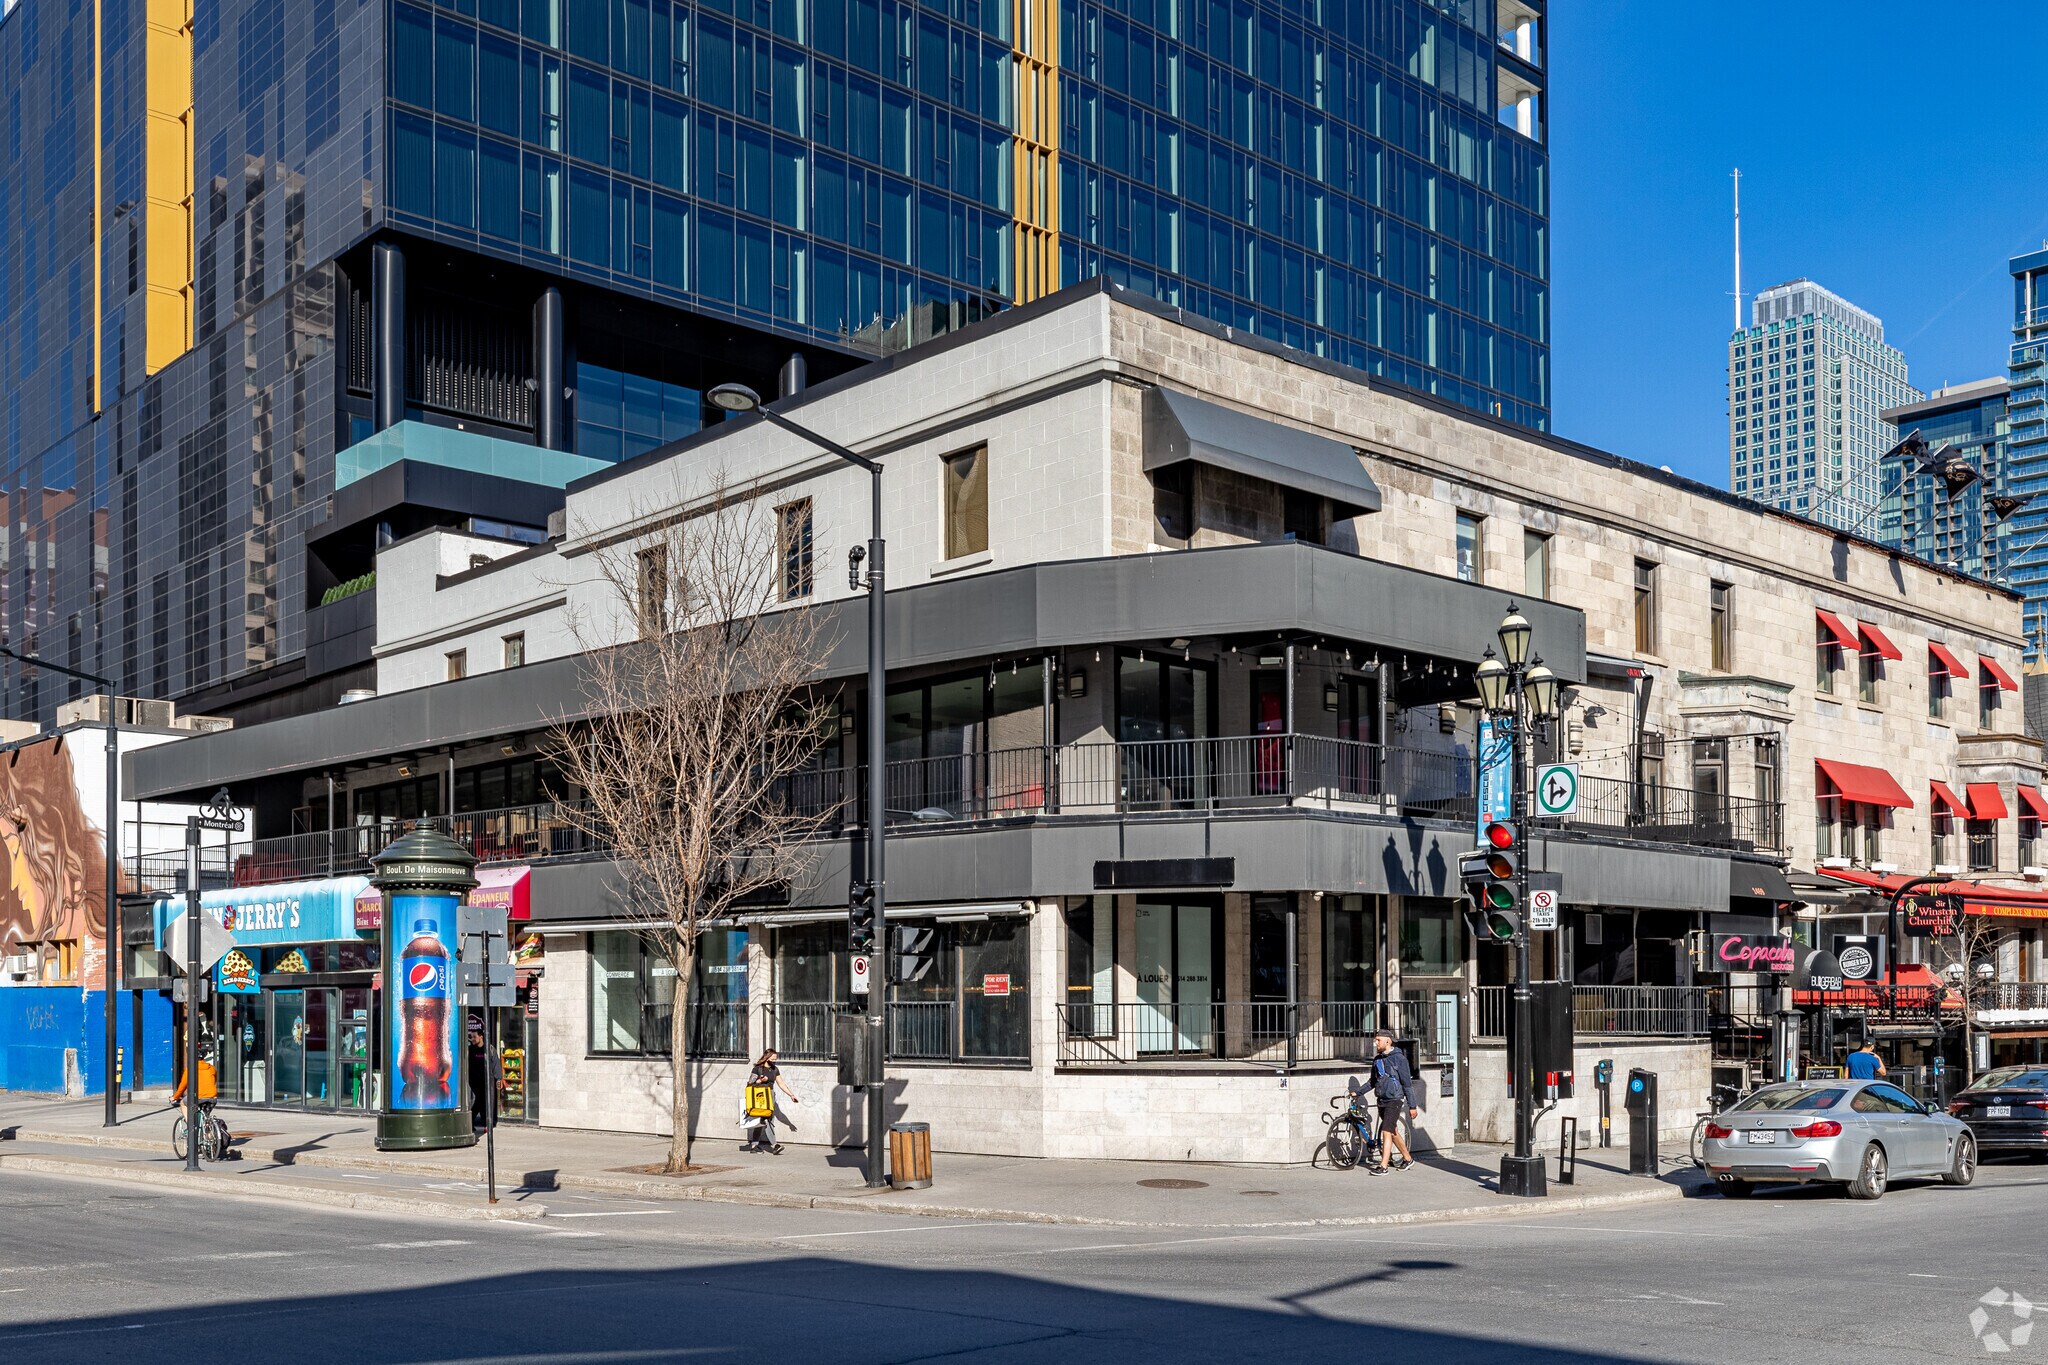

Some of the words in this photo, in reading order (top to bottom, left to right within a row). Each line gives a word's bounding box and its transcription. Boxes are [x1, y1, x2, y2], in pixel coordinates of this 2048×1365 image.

[203, 819, 234, 830] Montréal
[386, 865, 403, 875] Boul.
[404, 865, 415, 874] De
[417, 865, 466, 875] Maisonneuve
[235, 897, 300, 931] JERRY'S
[1917, 906, 1958, 916] Winston
[1993, 906, 2023, 916] COMPLEXE
[2023, 908, 2033, 917] SIR
[1908, 916, 1952, 927] Churchill
[1933, 925, 1953, 935] Pub
[1842, 959, 1860, 969] BURGER
[1859, 957, 1869, 965] BAR
[438, 965, 446, 991] pepsi
[1137, 972, 1143, 983] À
[1144, 974, 1169, 983] LOUER
